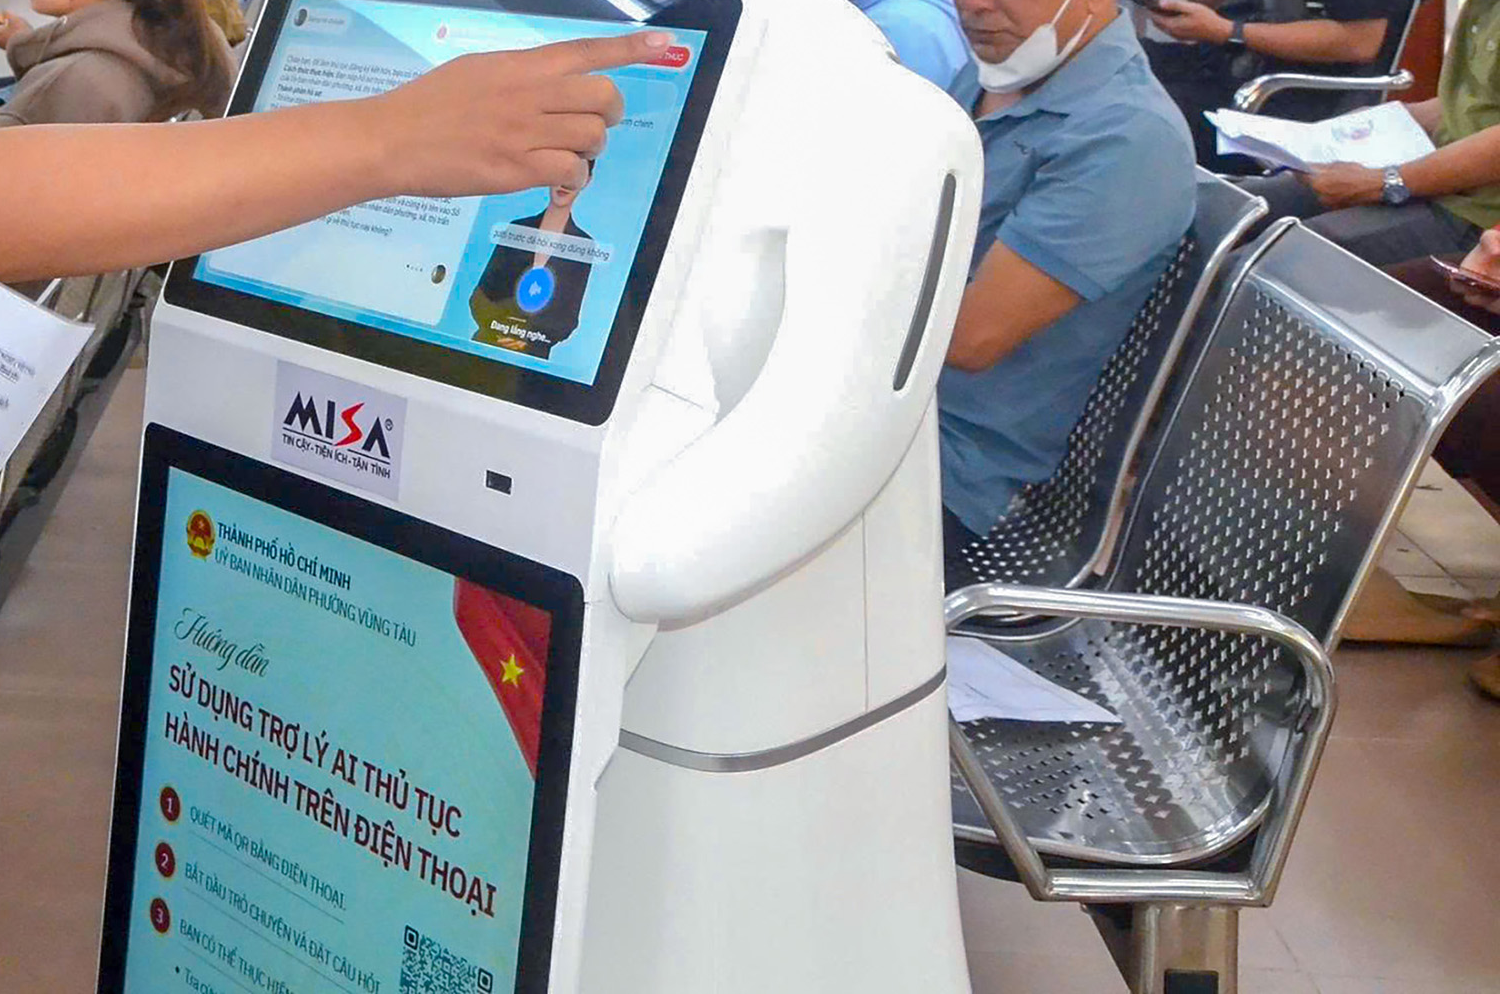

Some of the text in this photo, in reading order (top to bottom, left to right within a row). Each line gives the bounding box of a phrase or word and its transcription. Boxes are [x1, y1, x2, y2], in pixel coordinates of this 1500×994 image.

[282, 433, 295, 447] TIN
[315, 444, 333, 460] TIỆN
[334, 448, 347, 465] ÍCH
[352, 456, 368, 472] TẬN
[371, 463, 391, 479] TÌNH
[217, 522, 351, 591] THÀNH PHỐ HỒ CHÍ MINH
[174, 607, 270, 677] Hướng dẫn
[229, 554, 251, 577] BAN
[252, 563, 283, 591] NHÂN
[284, 577, 307, 601] DÂN
[308, 587, 356, 622] PHƯỜNG
[357, 607, 390, 636] VŨNG
[393, 620, 417, 647] TÀU
[168, 662, 463, 838] SỬ DỤNG TRỢ LÝ AI THỦ TỤC
[164, 710, 497, 919] HÀNH CHÍNH TRÊN ĐIỆN THOẠI
[190, 806, 217, 833] QUÉT
[217, 821, 233, 843] MÃ
[234, 832, 250, 852] QR
[281, 859, 309, 888] ĐIỆN
[228, 888, 249, 914] TRÒ
[249, 903, 292, 942] CHUYỆN
[332, 954, 357, 982] CÂU
